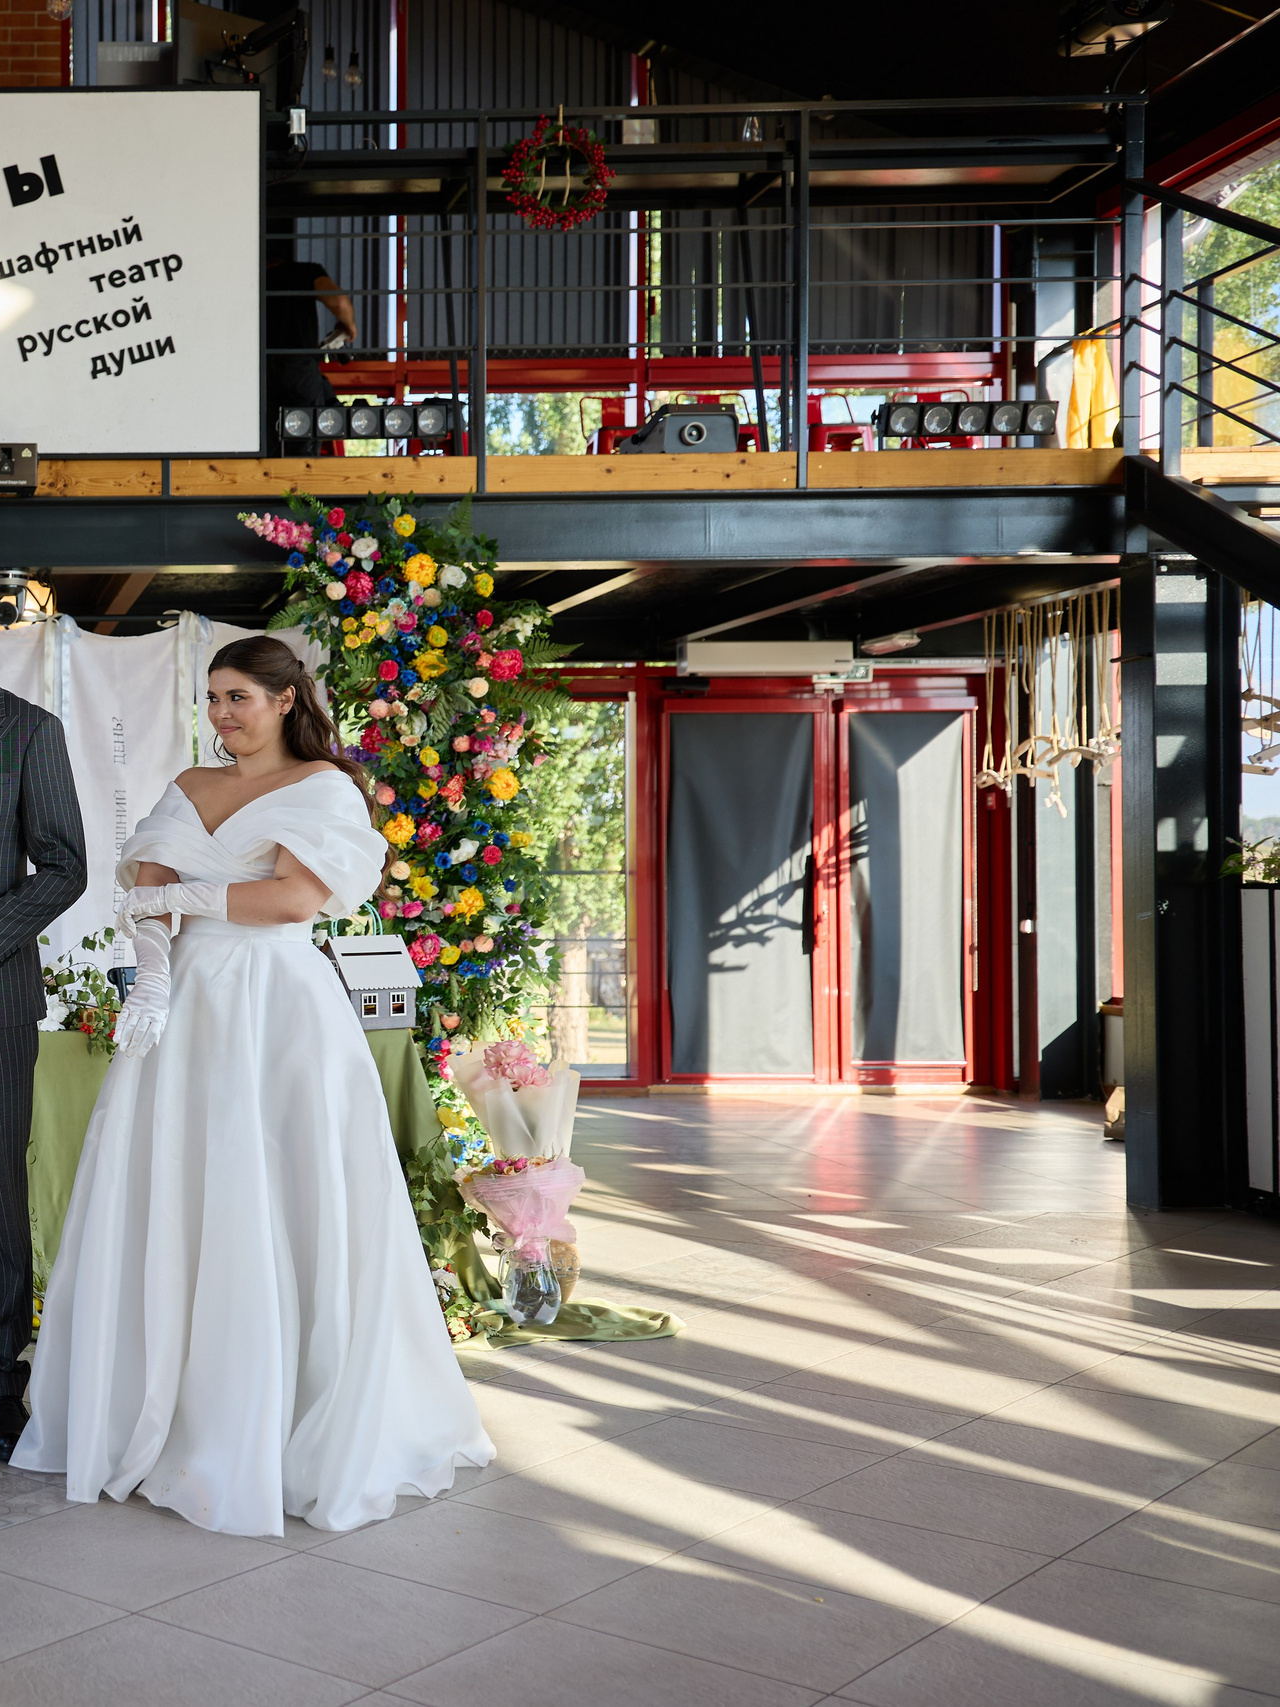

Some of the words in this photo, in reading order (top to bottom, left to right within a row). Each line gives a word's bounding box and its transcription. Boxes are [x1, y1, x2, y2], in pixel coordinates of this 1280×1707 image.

[88, 253, 184, 294] театр
[16, 296, 153, 363] русской
[90, 336, 177, 380] души
[111, 716, 127, 765] ДЕНЬ?
